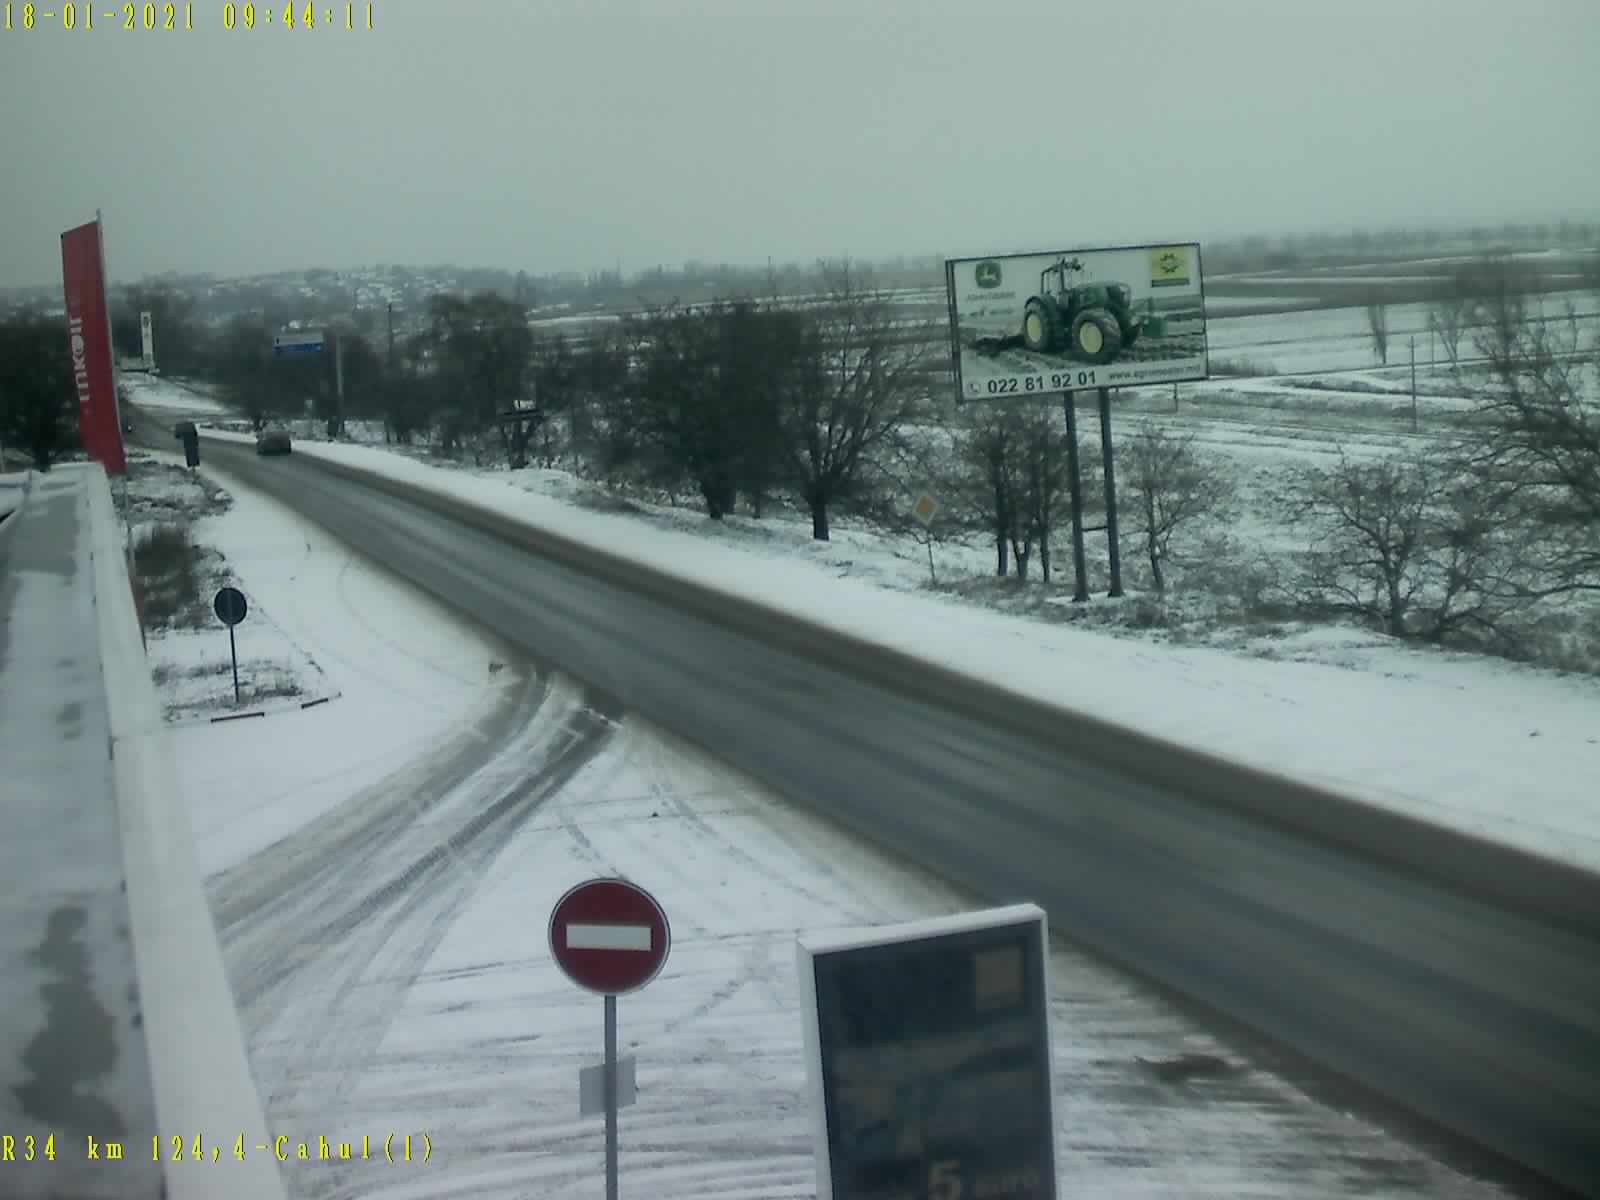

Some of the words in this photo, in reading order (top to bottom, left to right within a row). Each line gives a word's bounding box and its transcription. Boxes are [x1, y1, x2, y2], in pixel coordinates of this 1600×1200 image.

[987, 378, 1018, 393] 022
[1025, 376, 1044, 391] 81
[1051, 373, 1073, 388] 92
[1078, 370, 1096, 385] 01
